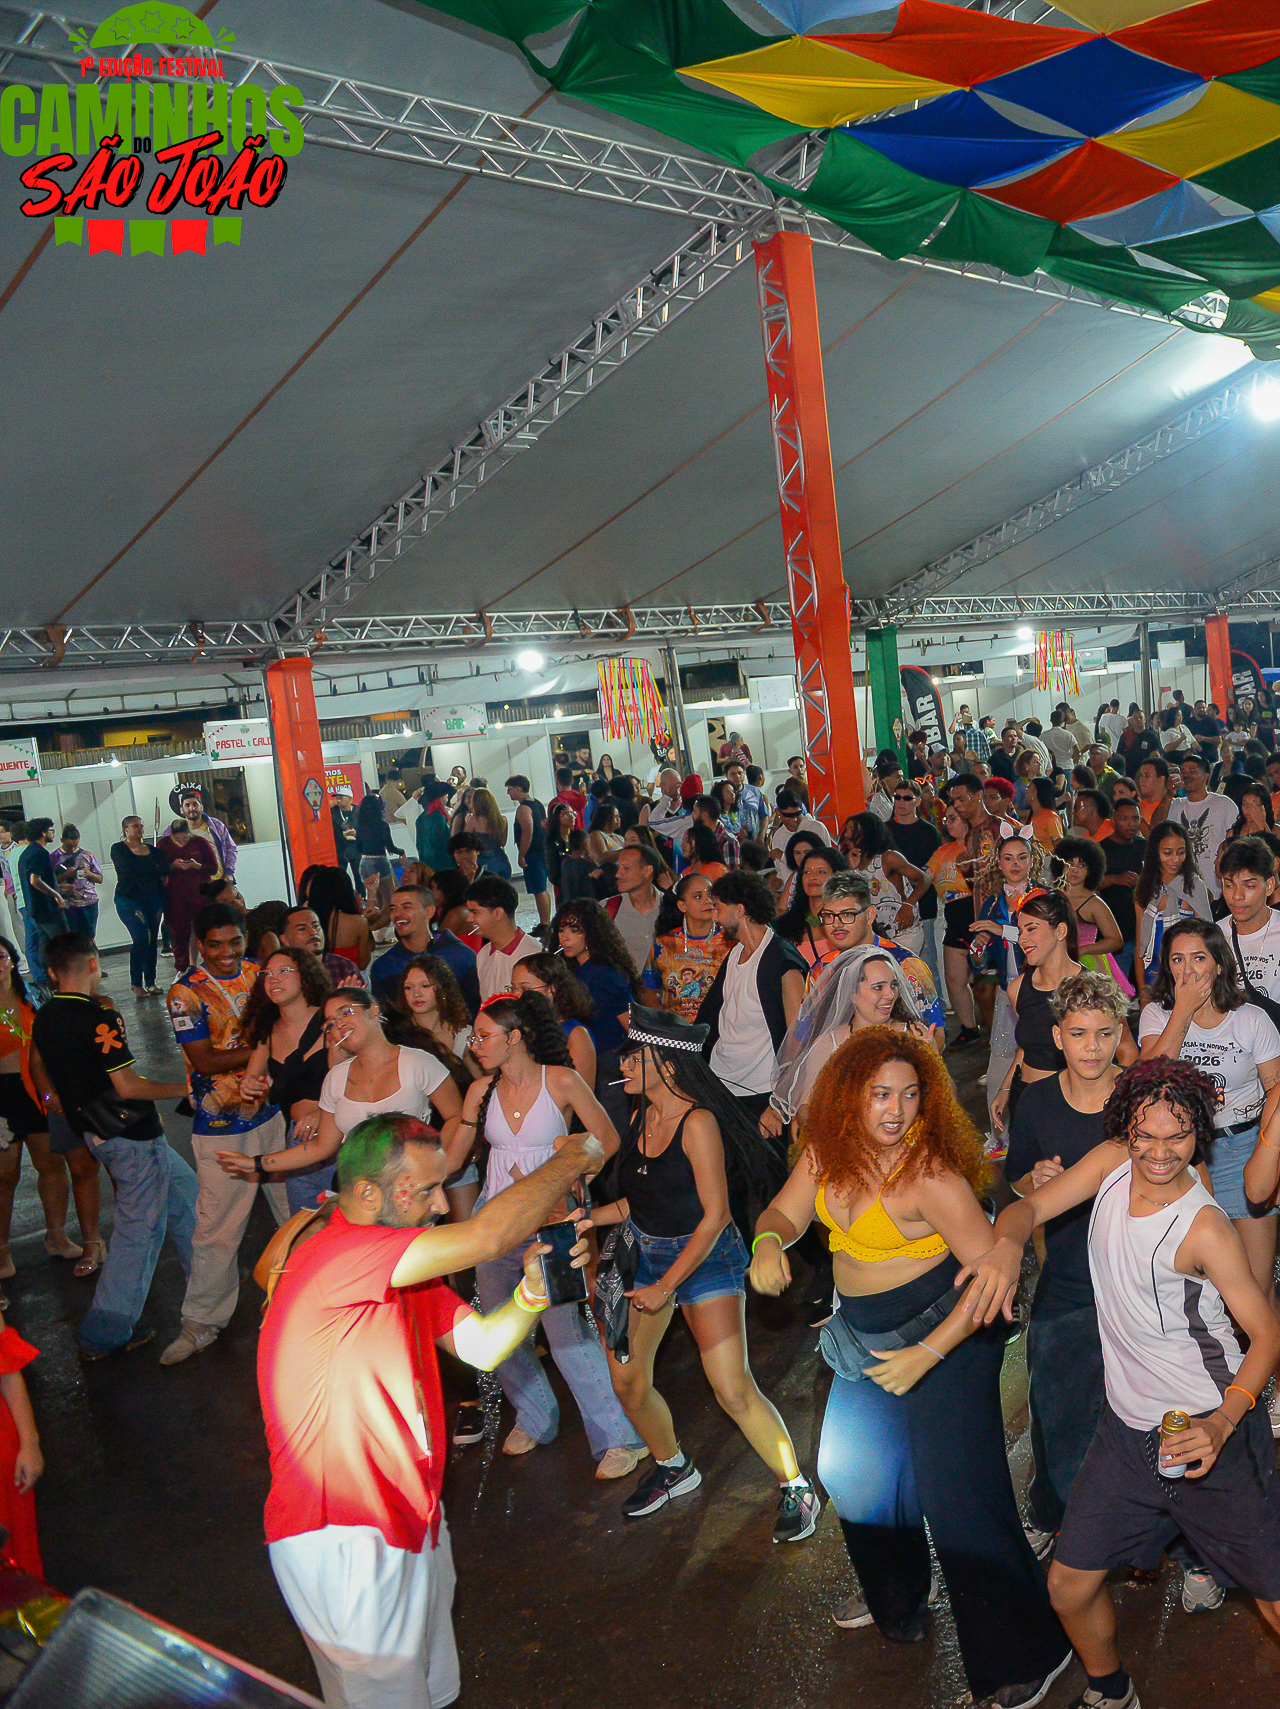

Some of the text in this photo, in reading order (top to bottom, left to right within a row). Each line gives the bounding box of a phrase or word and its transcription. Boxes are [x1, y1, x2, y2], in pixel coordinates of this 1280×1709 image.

[445, 718, 466, 731] BAR
[916, 694, 942, 744] BAR
[216, 738, 246, 749] PASTEL
[173, 781, 203, 793] CAIXA
[1206, 1043, 1229, 1052] NOIVOS
